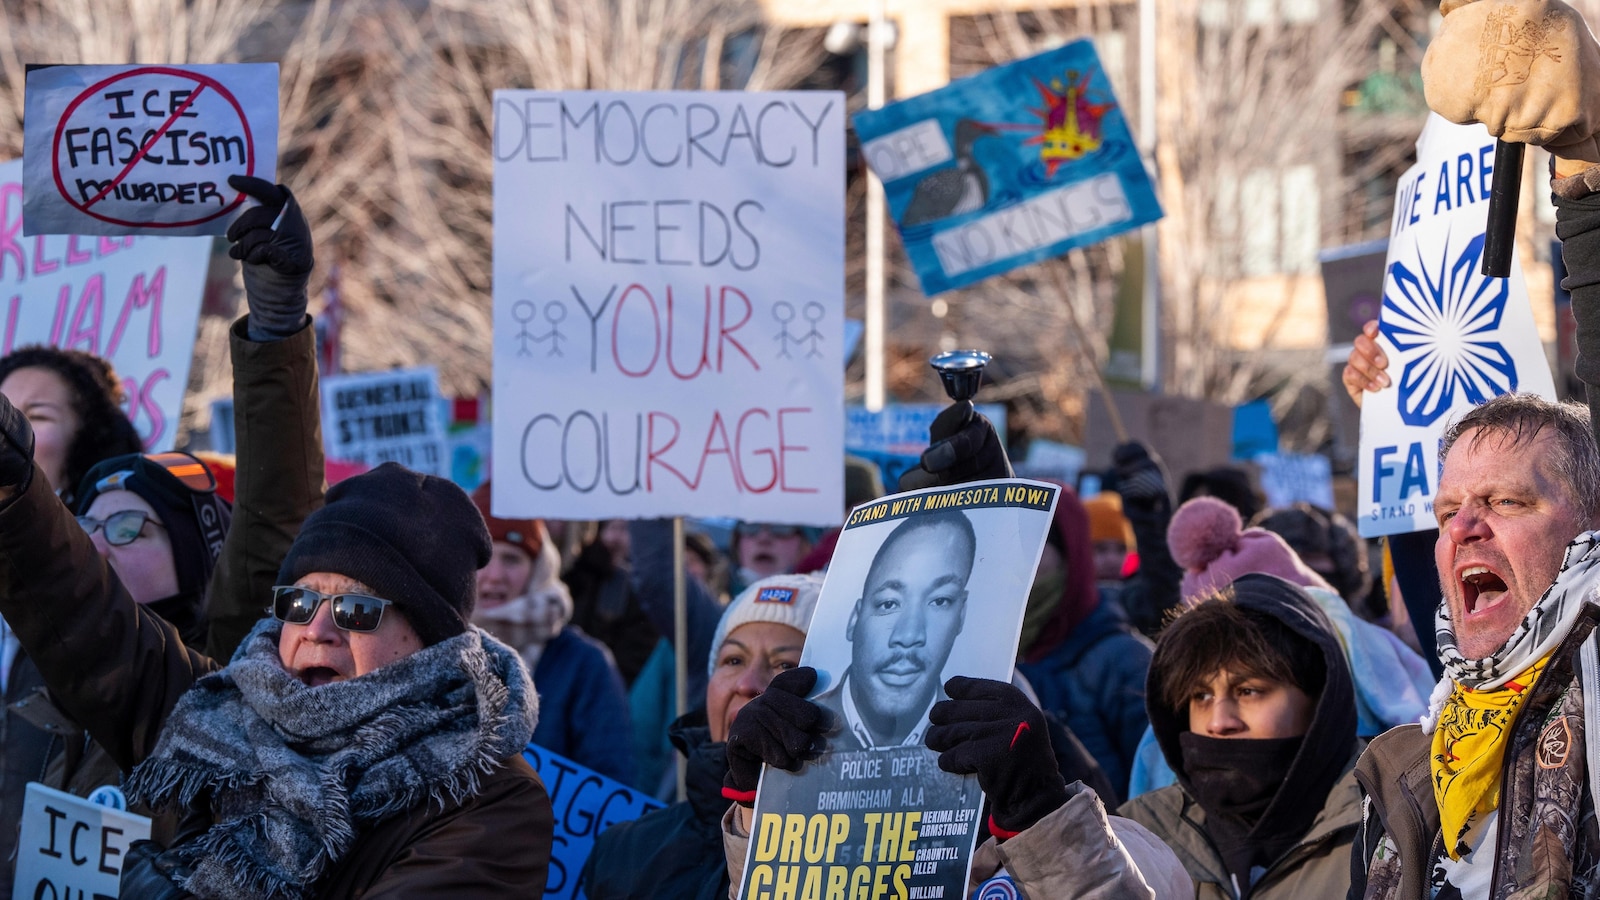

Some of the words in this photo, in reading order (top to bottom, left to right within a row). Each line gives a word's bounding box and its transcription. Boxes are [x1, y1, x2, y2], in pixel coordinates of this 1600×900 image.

[104, 90, 199, 119] ICE
[494, 98, 834, 169] DEMOCRACY
[1393, 172, 1426, 238] WE
[1434, 144, 1494, 216] ARE
[564, 200, 765, 271] NEEDS
[936, 222, 997, 272] NO
[998, 174, 1126, 251] KINGS
[570, 283, 761, 381] YOUR
[336, 380, 430, 410] GENERAL
[340, 410, 426, 444] STRIKE
[519, 408, 820, 495] COURAGE
[1373, 438, 1443, 503] FA
[849, 508, 887, 525] STAND
[891, 497, 923, 516] WITH
[924, 487, 999, 511] MINNESOTA
[1004, 486, 1049, 506] NOW!
[1371, 504, 1415, 521] STAND
[201, 504, 223, 557] GIR
[759, 588, 793, 602] HAPPY
[840, 758, 883, 781] POLICE
[891, 756, 923, 776] DEPT
[817, 788, 892, 811] BIRMINGHAM
[900, 786, 925, 807] ALA
[919, 823, 968, 838] ARMSTRONG
[922, 811, 953, 824] NEKIMA
[955, 809, 976, 822] LEVY
[39, 805, 124, 876] ICE
[755, 813, 850, 864] DROP
[863, 811, 921, 863] THE
[915, 847, 959, 861] CHAUNTYLL
[747, 864, 912, 900] CHARGES
[912, 861, 938, 876] ALLEN
[909, 885, 945, 899] WILLIAM
